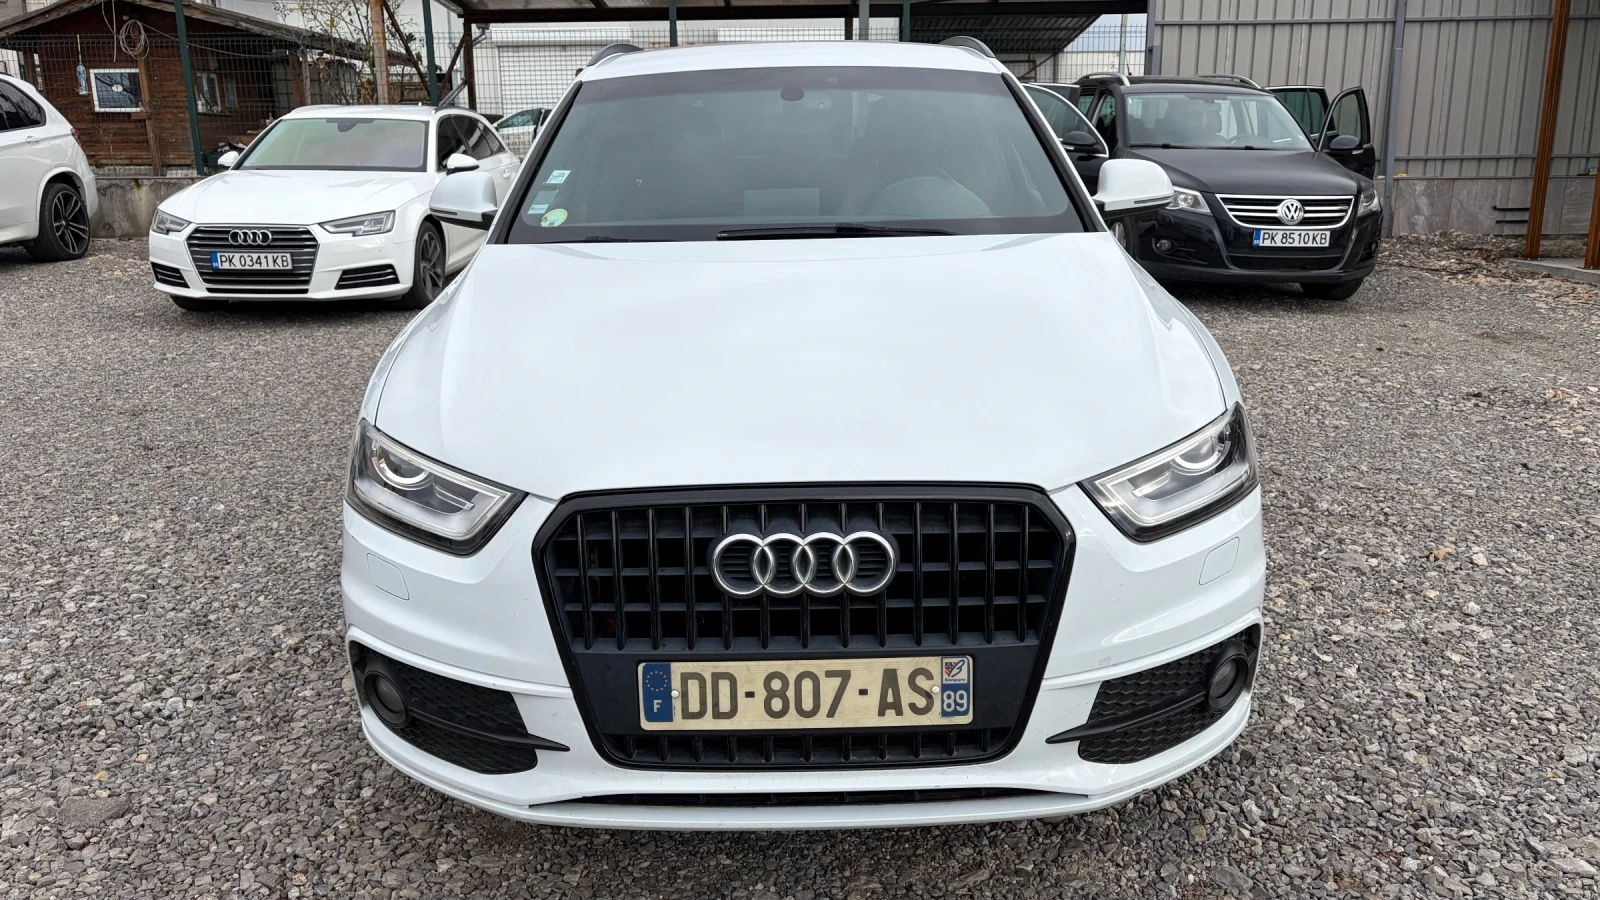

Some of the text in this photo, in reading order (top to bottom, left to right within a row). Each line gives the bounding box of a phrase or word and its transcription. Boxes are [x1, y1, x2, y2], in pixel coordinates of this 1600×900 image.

[1262, 232, 1328, 245] PK 8510 KB
[219, 254, 290, 268] PK 0341 KB
[680, 667, 935, 721] DD-807-AS
[943, 690, 968, 712] 89
[653, 699, 662, 713] F
